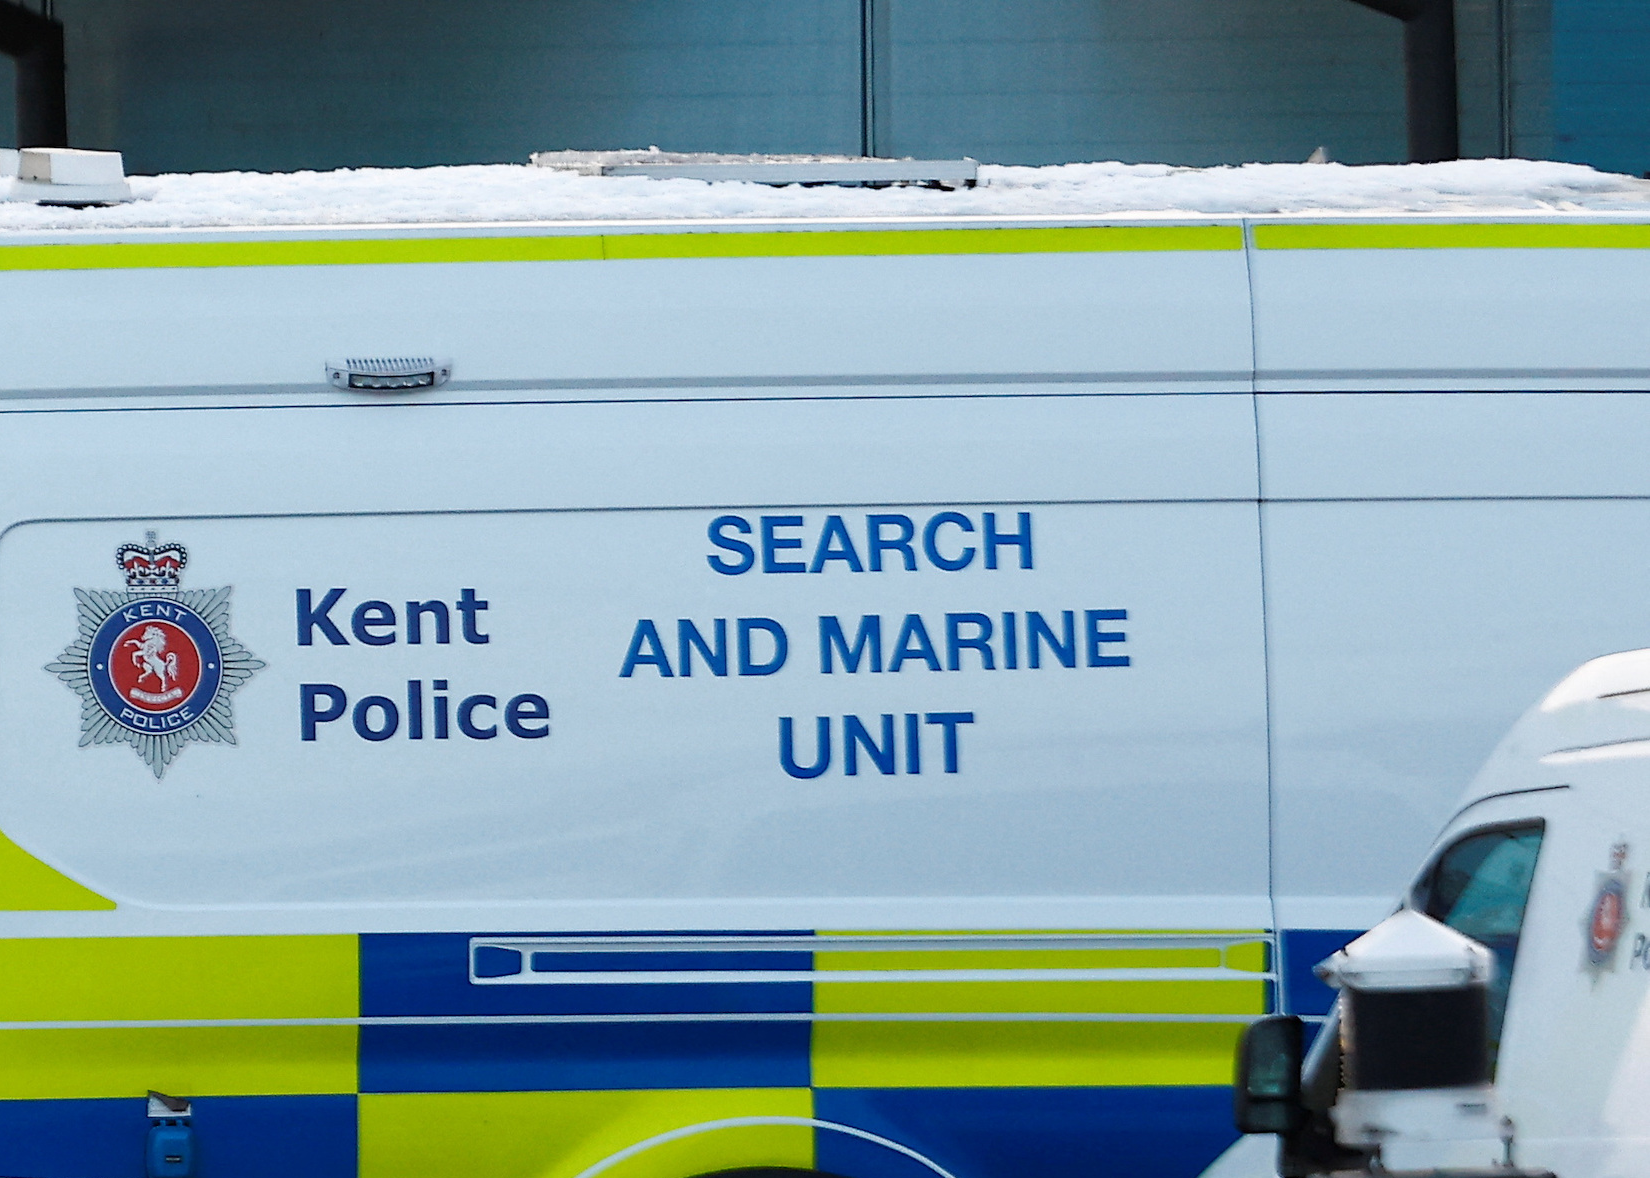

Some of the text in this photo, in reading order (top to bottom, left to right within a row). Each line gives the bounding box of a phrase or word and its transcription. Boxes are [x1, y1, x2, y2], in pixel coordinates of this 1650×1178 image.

[706, 511, 1034, 575] SEARCH
[123, 604, 187, 622] KENT
[295, 587, 489, 646] Kent
[619, 608, 1131, 678] AND MARINE
[120, 706, 194, 729] POLICE
[299, 678, 550, 742] Police
[778, 711, 974, 779] UNIT
